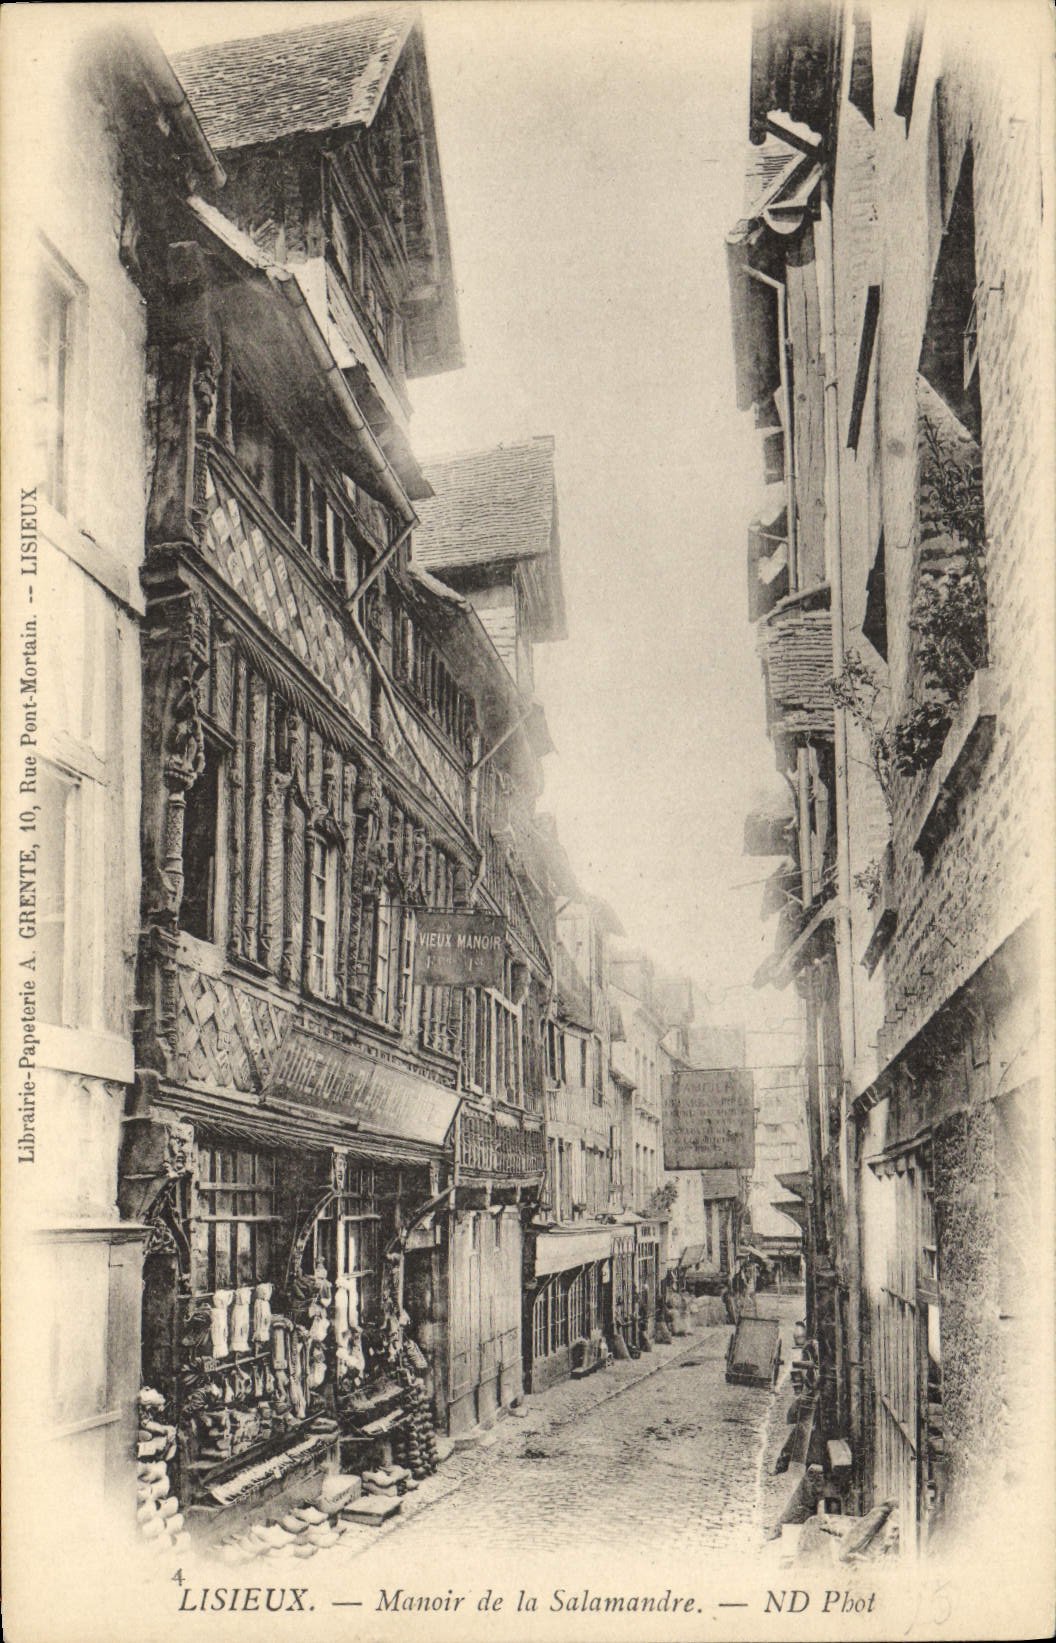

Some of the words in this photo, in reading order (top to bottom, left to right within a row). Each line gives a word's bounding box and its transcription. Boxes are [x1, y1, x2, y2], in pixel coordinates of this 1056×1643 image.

[419, 932, 451, 948] VIEUX
[457, 934, 502, 950] MANOIR
[276, 1046, 341, 1099] BUREAU
